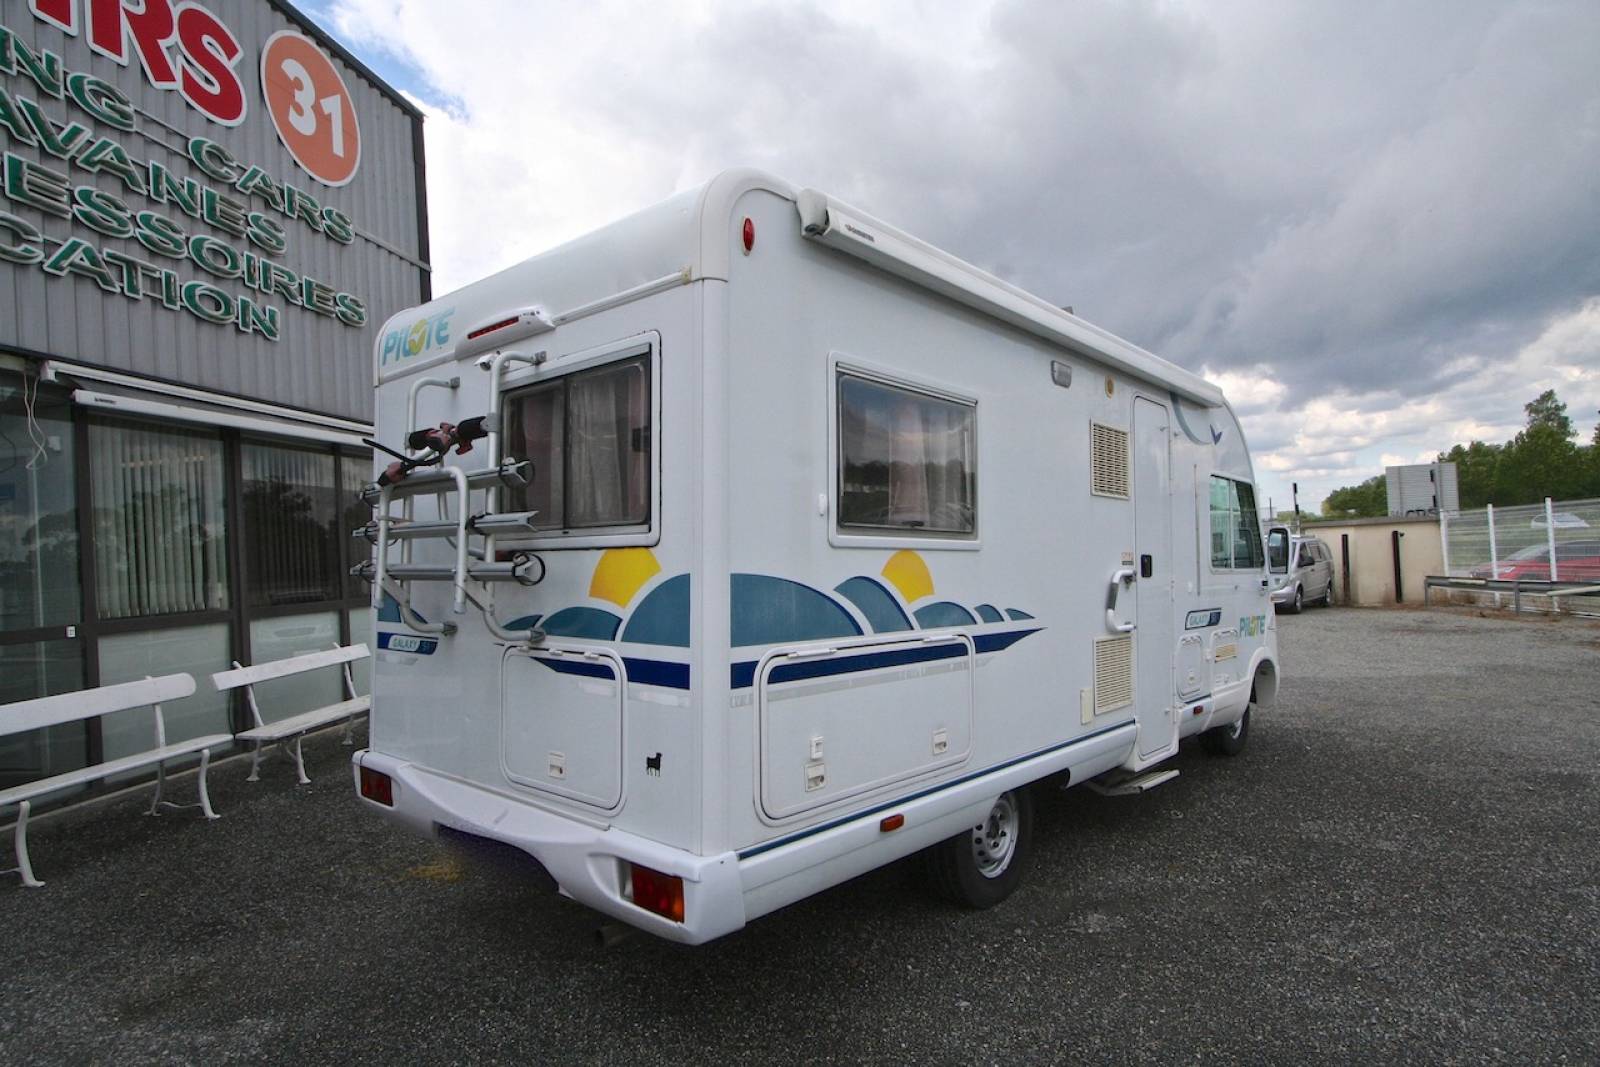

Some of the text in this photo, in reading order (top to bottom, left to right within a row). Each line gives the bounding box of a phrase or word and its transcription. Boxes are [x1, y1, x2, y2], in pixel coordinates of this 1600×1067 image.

[281, 58, 345, 158] 31
[188, 137, 355, 245] CARS
[381, 306, 455, 367] PILOTE
